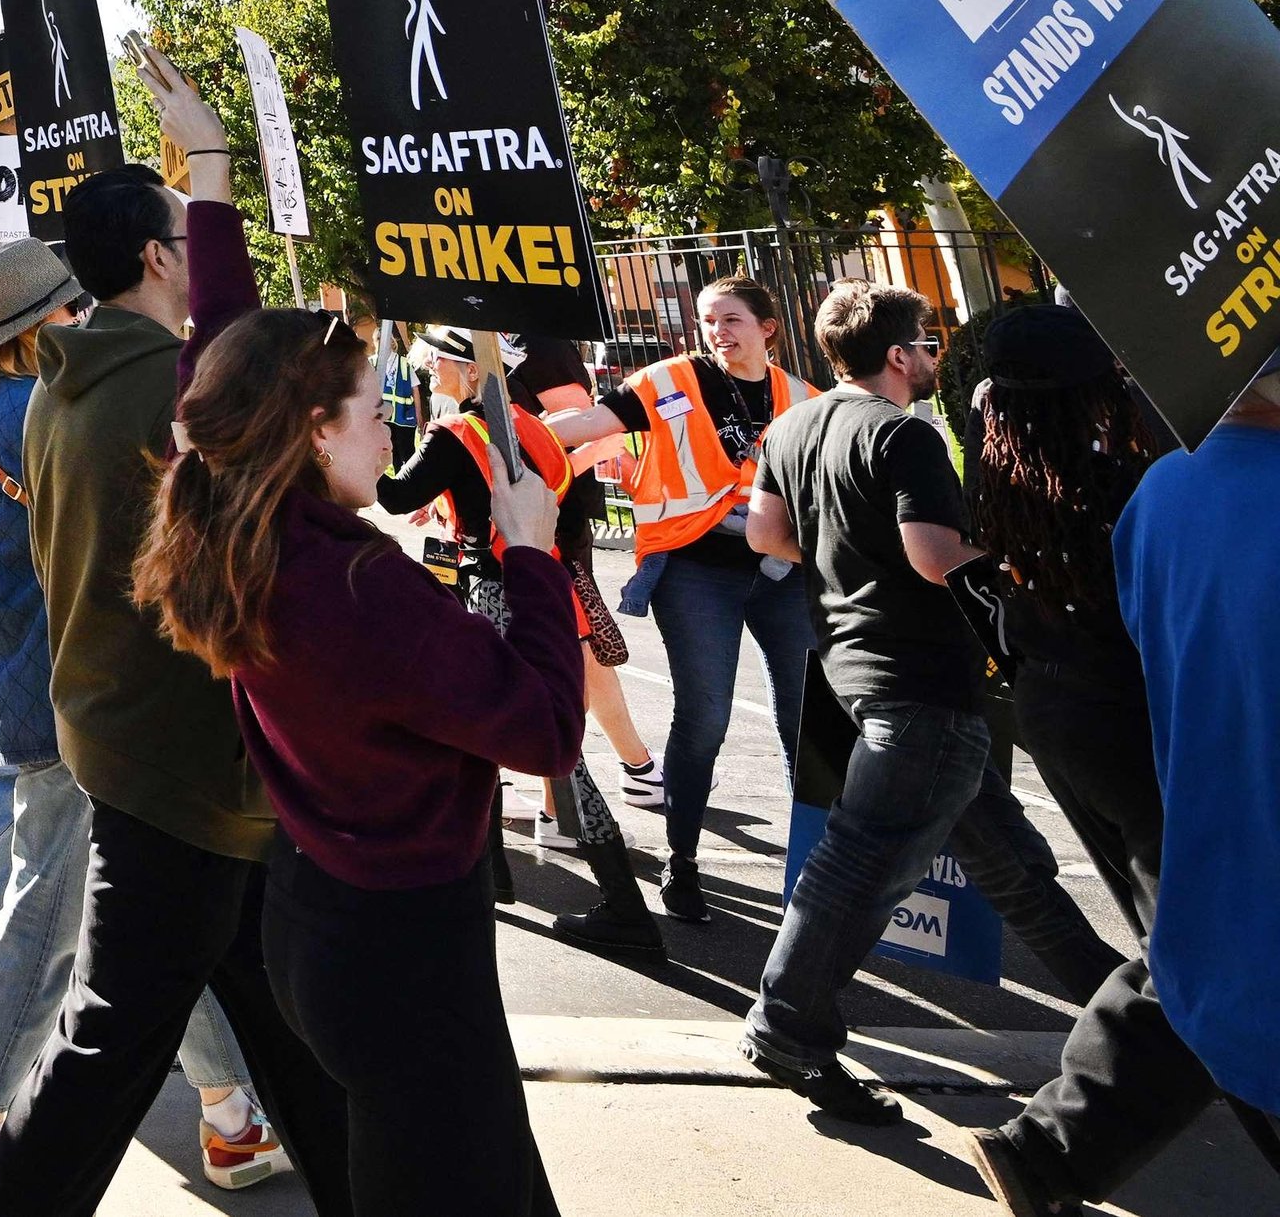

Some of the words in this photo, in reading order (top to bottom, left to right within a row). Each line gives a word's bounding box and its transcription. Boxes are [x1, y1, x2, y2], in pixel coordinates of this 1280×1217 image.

[981, 0, 1096, 126] STANDS
[67, 152, 85, 171] ON
[434, 188, 474, 216] ON
[375, 221, 581, 288] STRIKE!
[1236, 226, 1268, 265] ON
[1206, 237, 1280, 358] STRI
